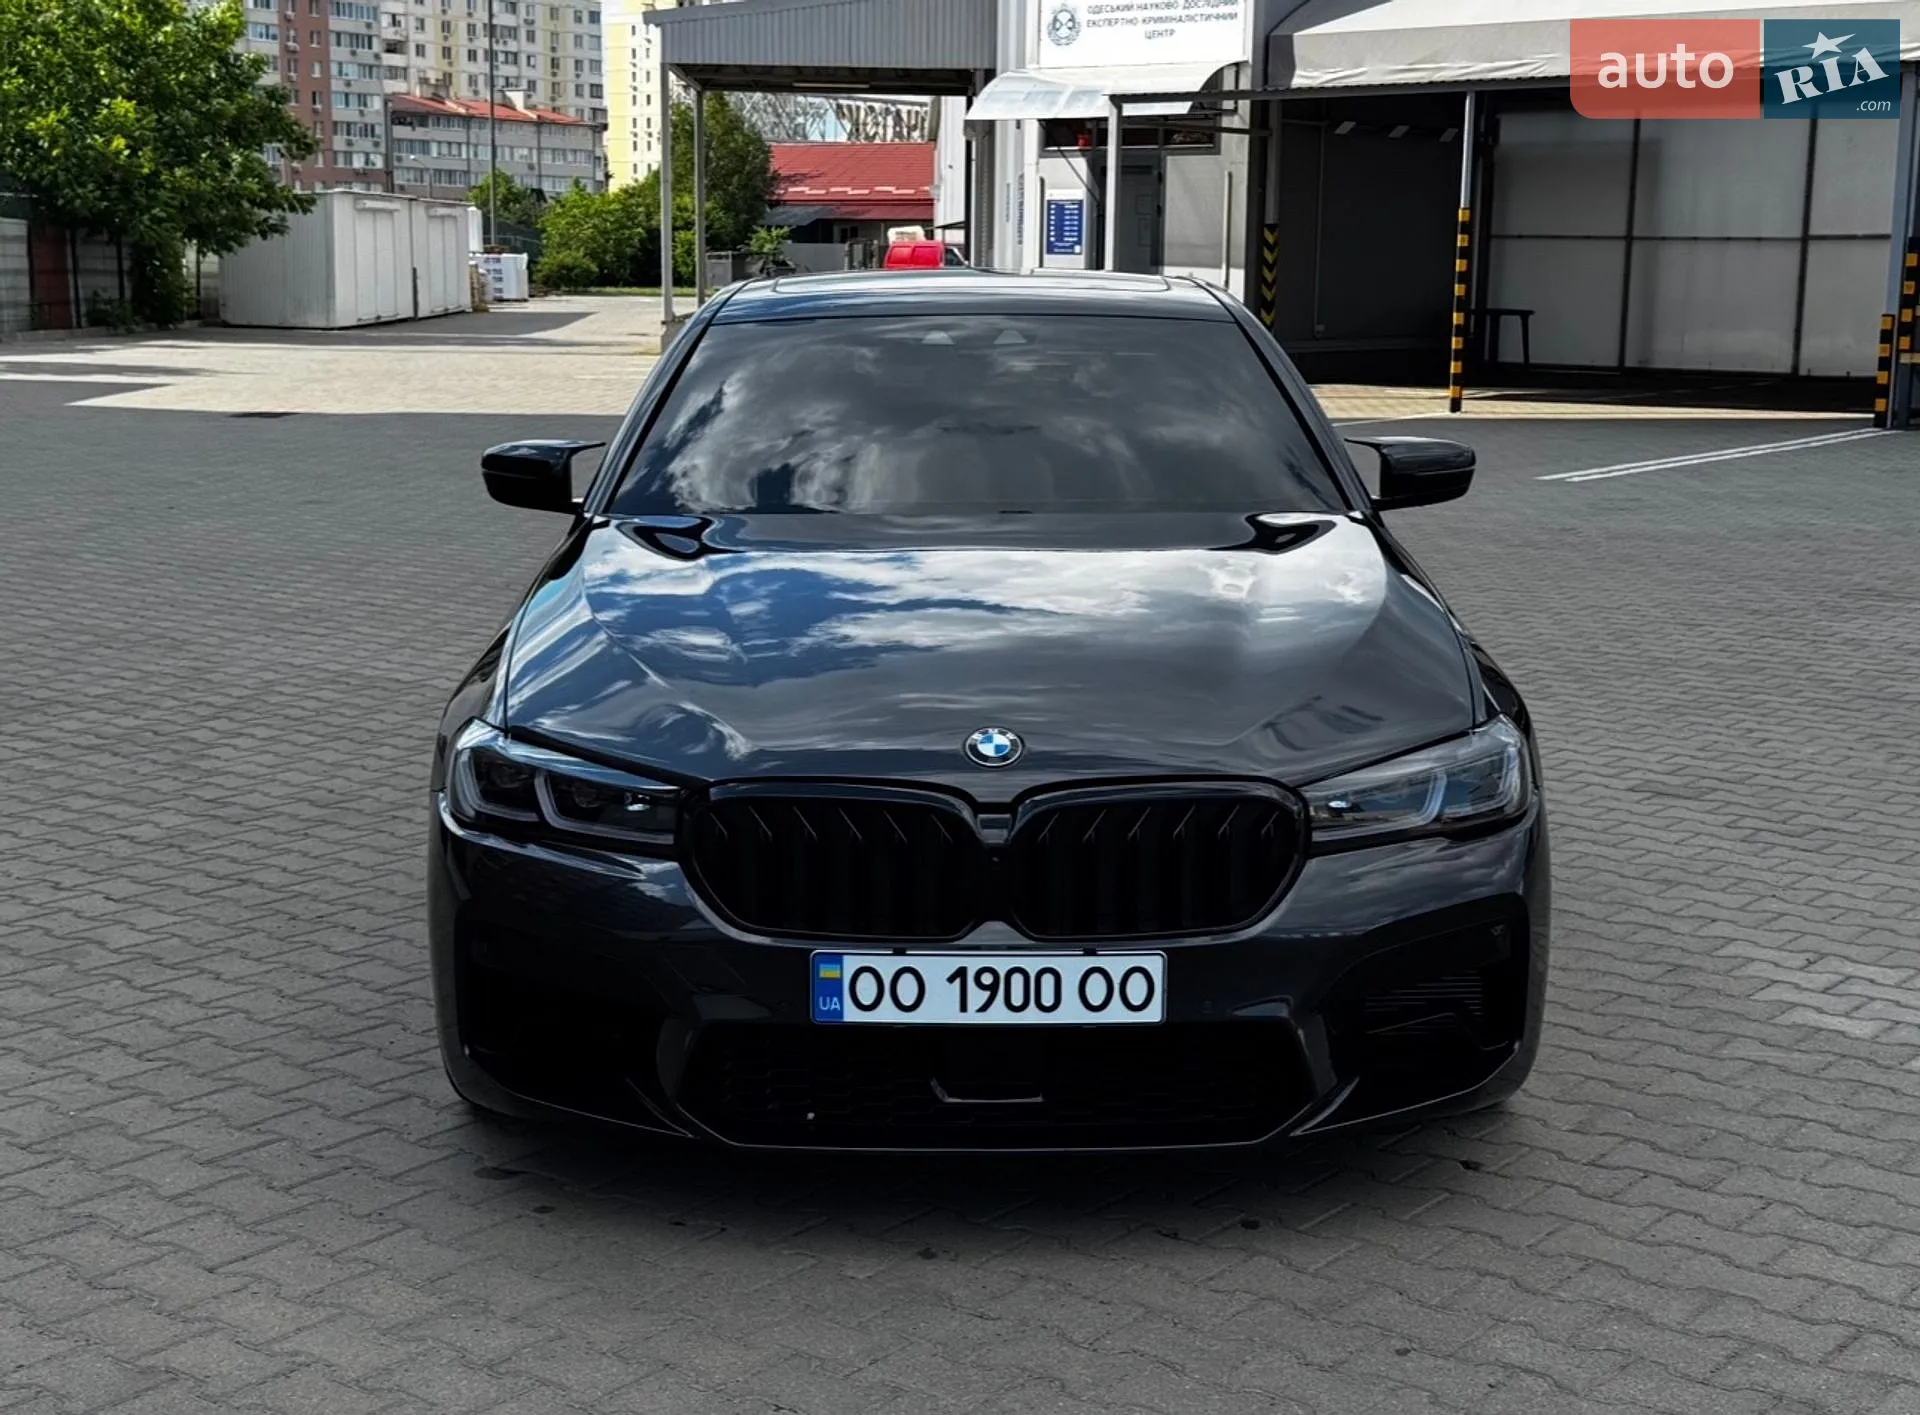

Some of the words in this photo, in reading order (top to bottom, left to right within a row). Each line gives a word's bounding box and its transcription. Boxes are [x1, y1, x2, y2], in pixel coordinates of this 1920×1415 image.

[1144, 28, 1176, 40] ЦЕНТР
[946, 965, 1062, 1013] 1900
[819, 995, 841, 1011] UA
